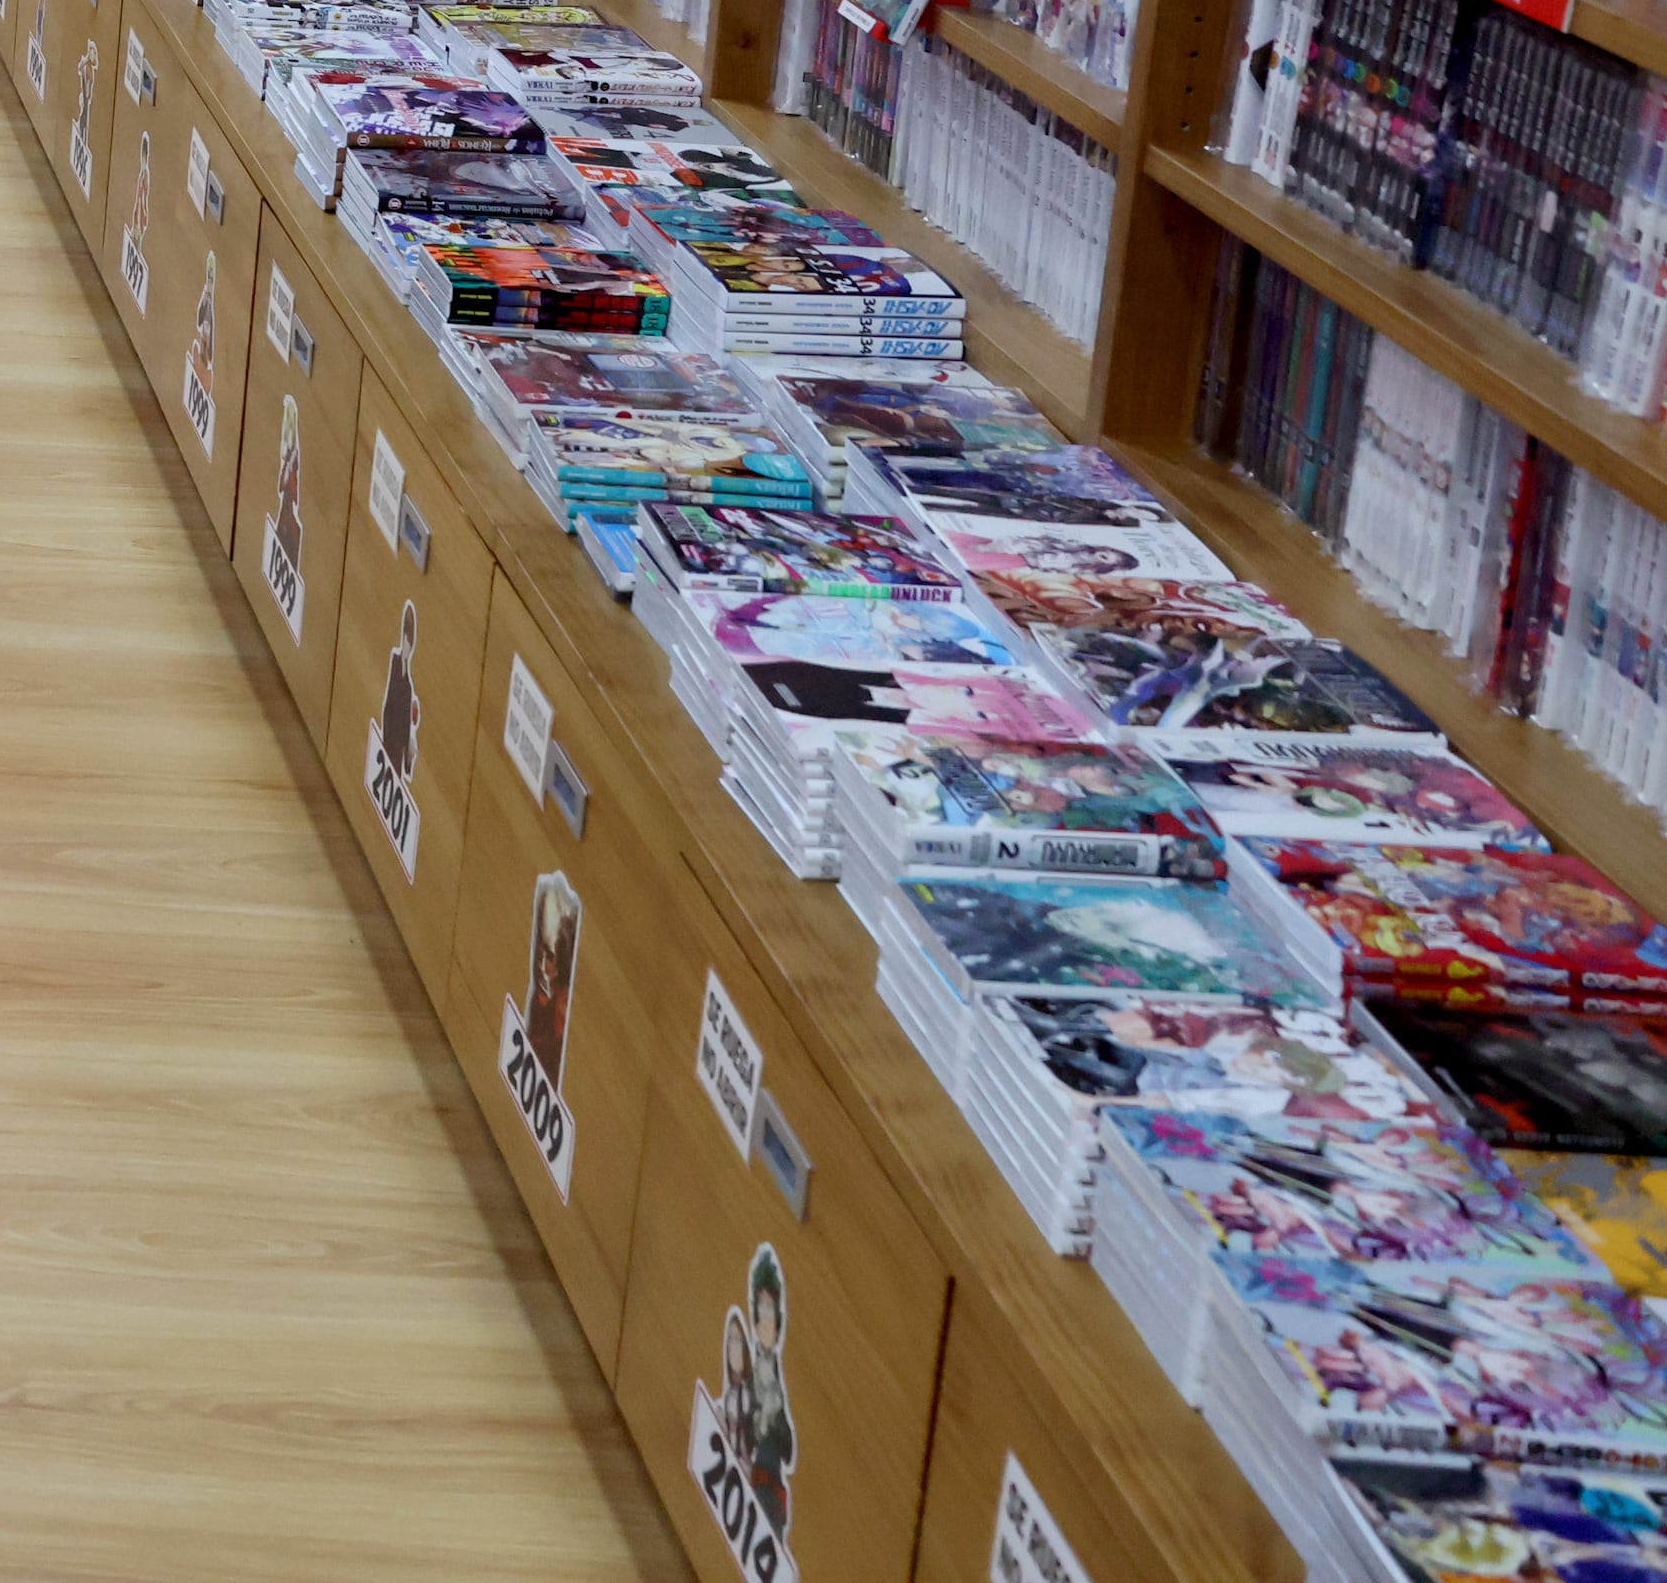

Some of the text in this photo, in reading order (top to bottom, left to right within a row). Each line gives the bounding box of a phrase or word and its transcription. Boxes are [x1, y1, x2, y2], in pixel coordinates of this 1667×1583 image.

[458, 138, 493, 153] REINOS
[125, 242, 146, 301] 1997
[861, 297, 877, 316] 34
[187, 372, 211, 439] 1999
[268, 539, 298, 618] 1999
[890, 585, 954, 603] UNLUCK
[372, 748, 411, 855] 2001
[996, 839, 1021, 861] 2
[707, 989, 755, 1093] SE RUEGA
[507, 1027, 564, 1165] 2009
